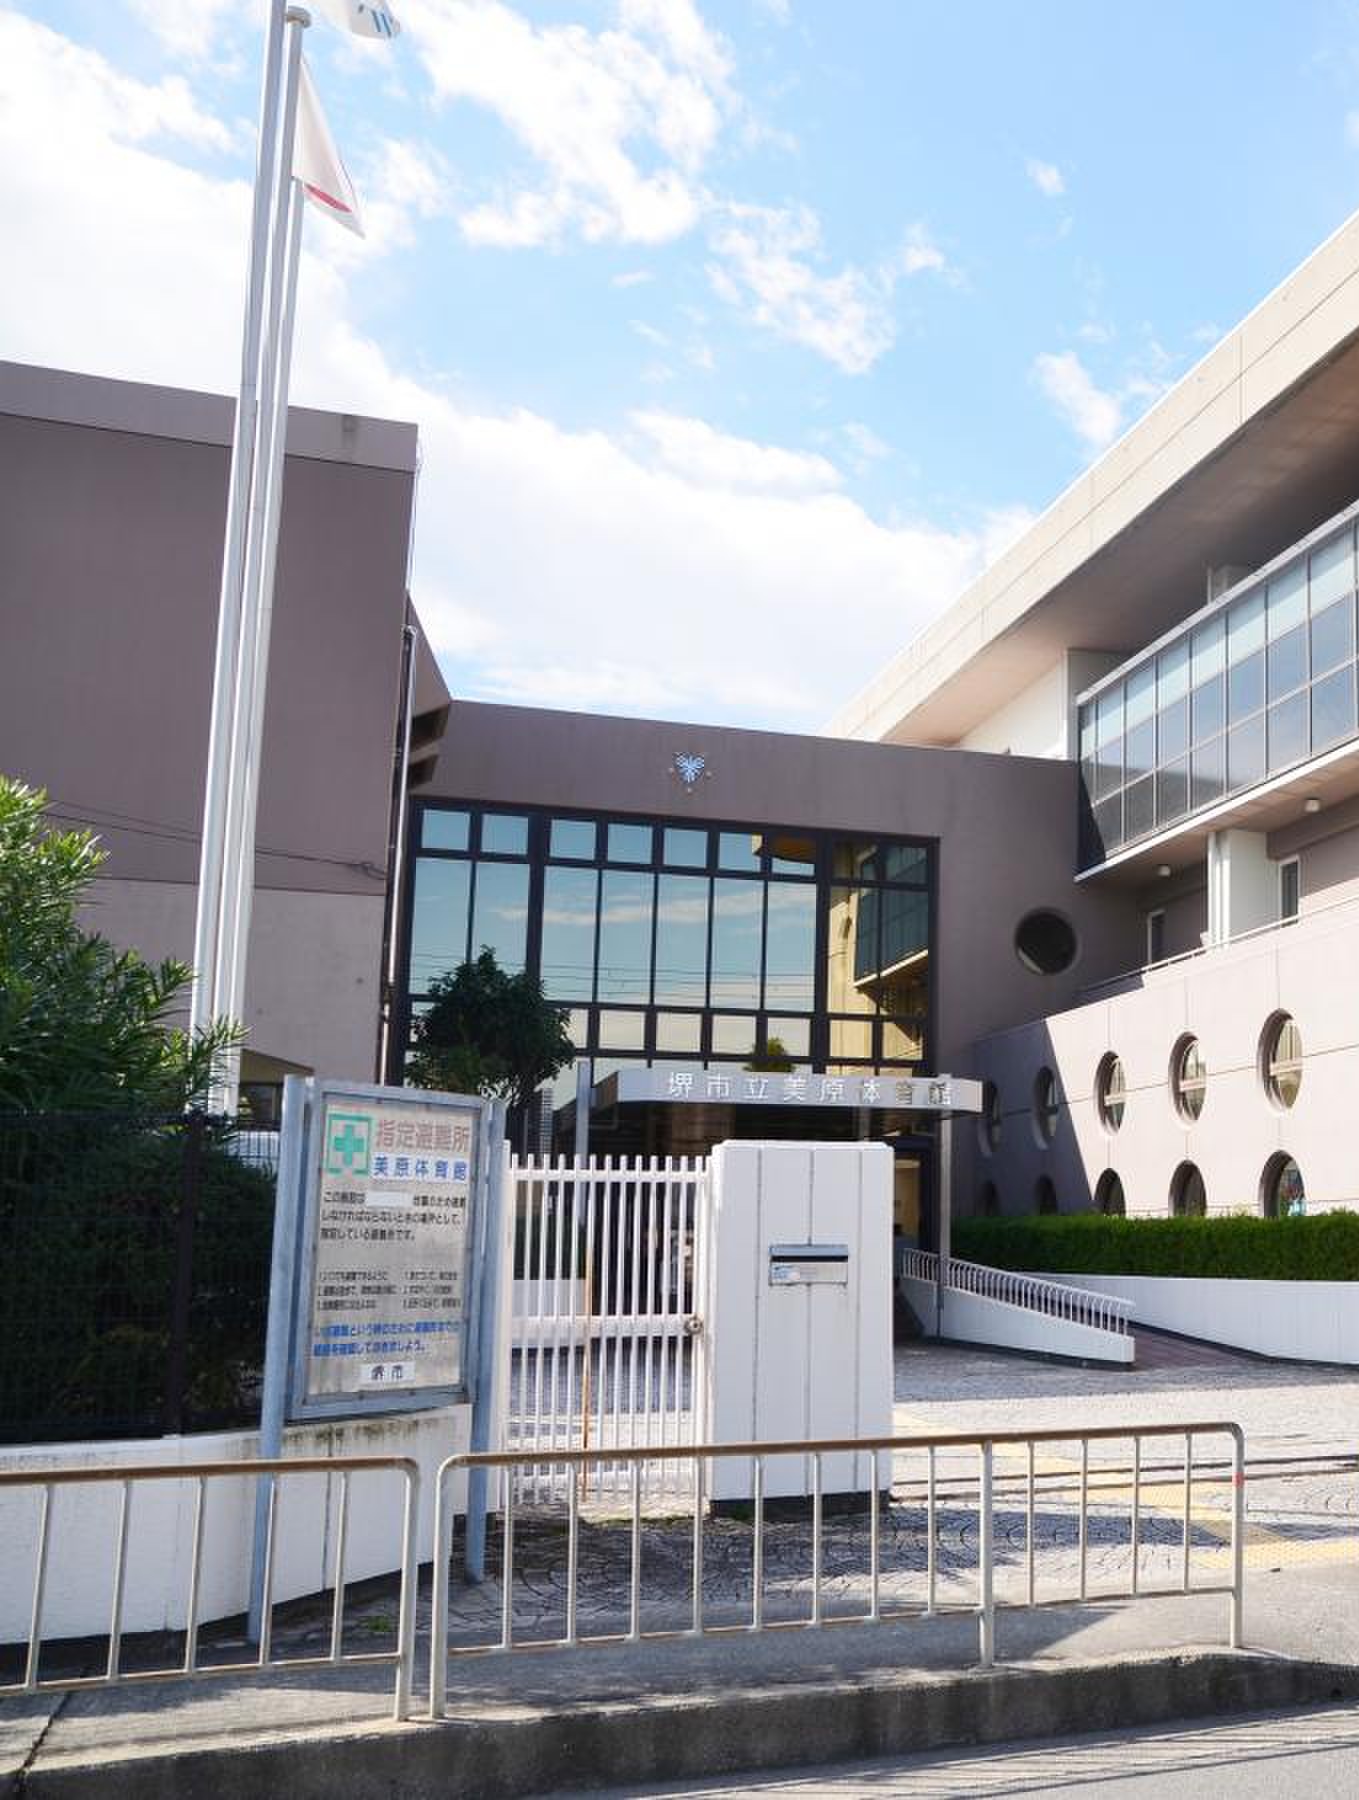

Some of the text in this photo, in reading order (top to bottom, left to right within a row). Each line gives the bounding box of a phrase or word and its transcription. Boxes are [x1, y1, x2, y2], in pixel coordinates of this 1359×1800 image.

[668, 1071, 953, 1106] 堺市立美原体育館
[376, 1119, 469, 1152] 指定避難所
[373, 1156, 468, 1181] 美原体育館
